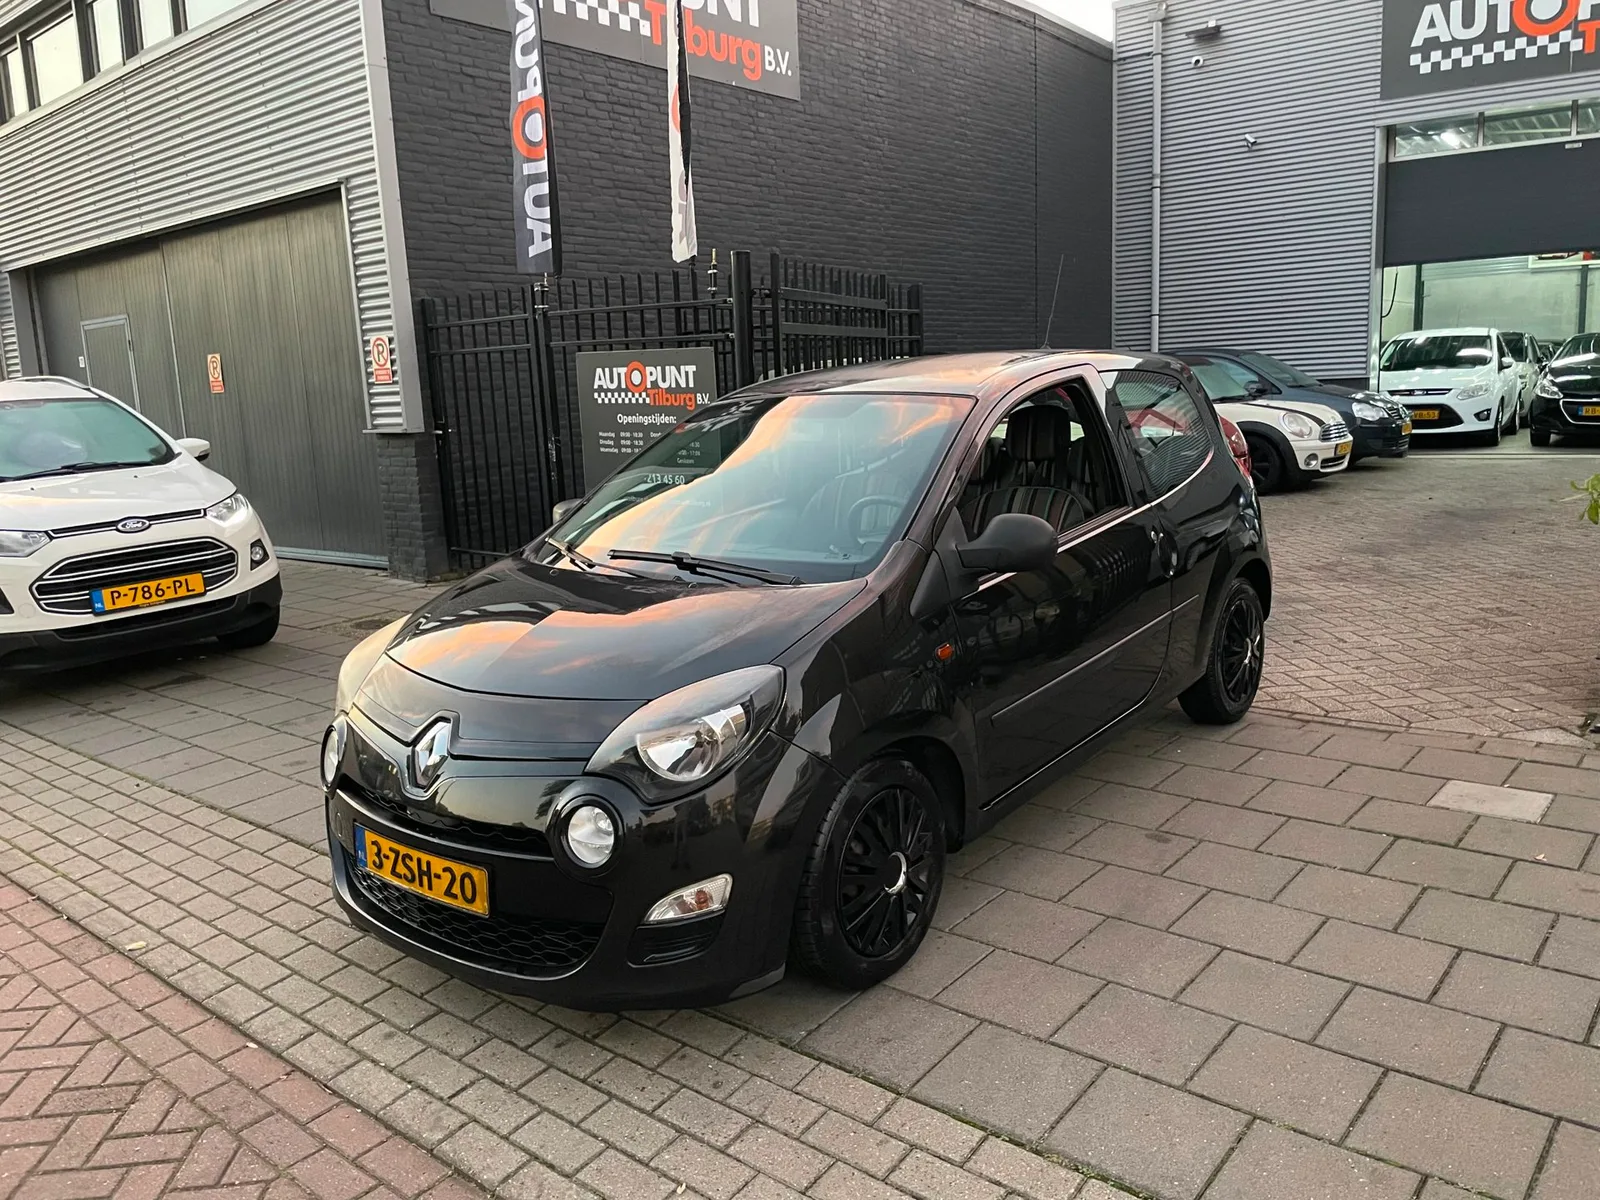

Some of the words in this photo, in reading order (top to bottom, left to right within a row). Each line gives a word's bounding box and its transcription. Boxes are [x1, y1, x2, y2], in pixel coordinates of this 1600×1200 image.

[645, 0, 762, 81] Tburg
[764, 45, 792, 76] B.V.
[593, 361, 697, 393] AUTOPUNT
[647, 388, 696, 410] Tilburg
[697, 393, 710, 404] B.V.
[617, 413, 677, 426] Openingstijden:
[664, 474, 673, 484] 45
[675, 475, 685, 485] 60
[110, 578, 196, 606] P-786-PL
[358, 850, 367, 862] NL
[371, 840, 477, 904] 3-ZSH-20
